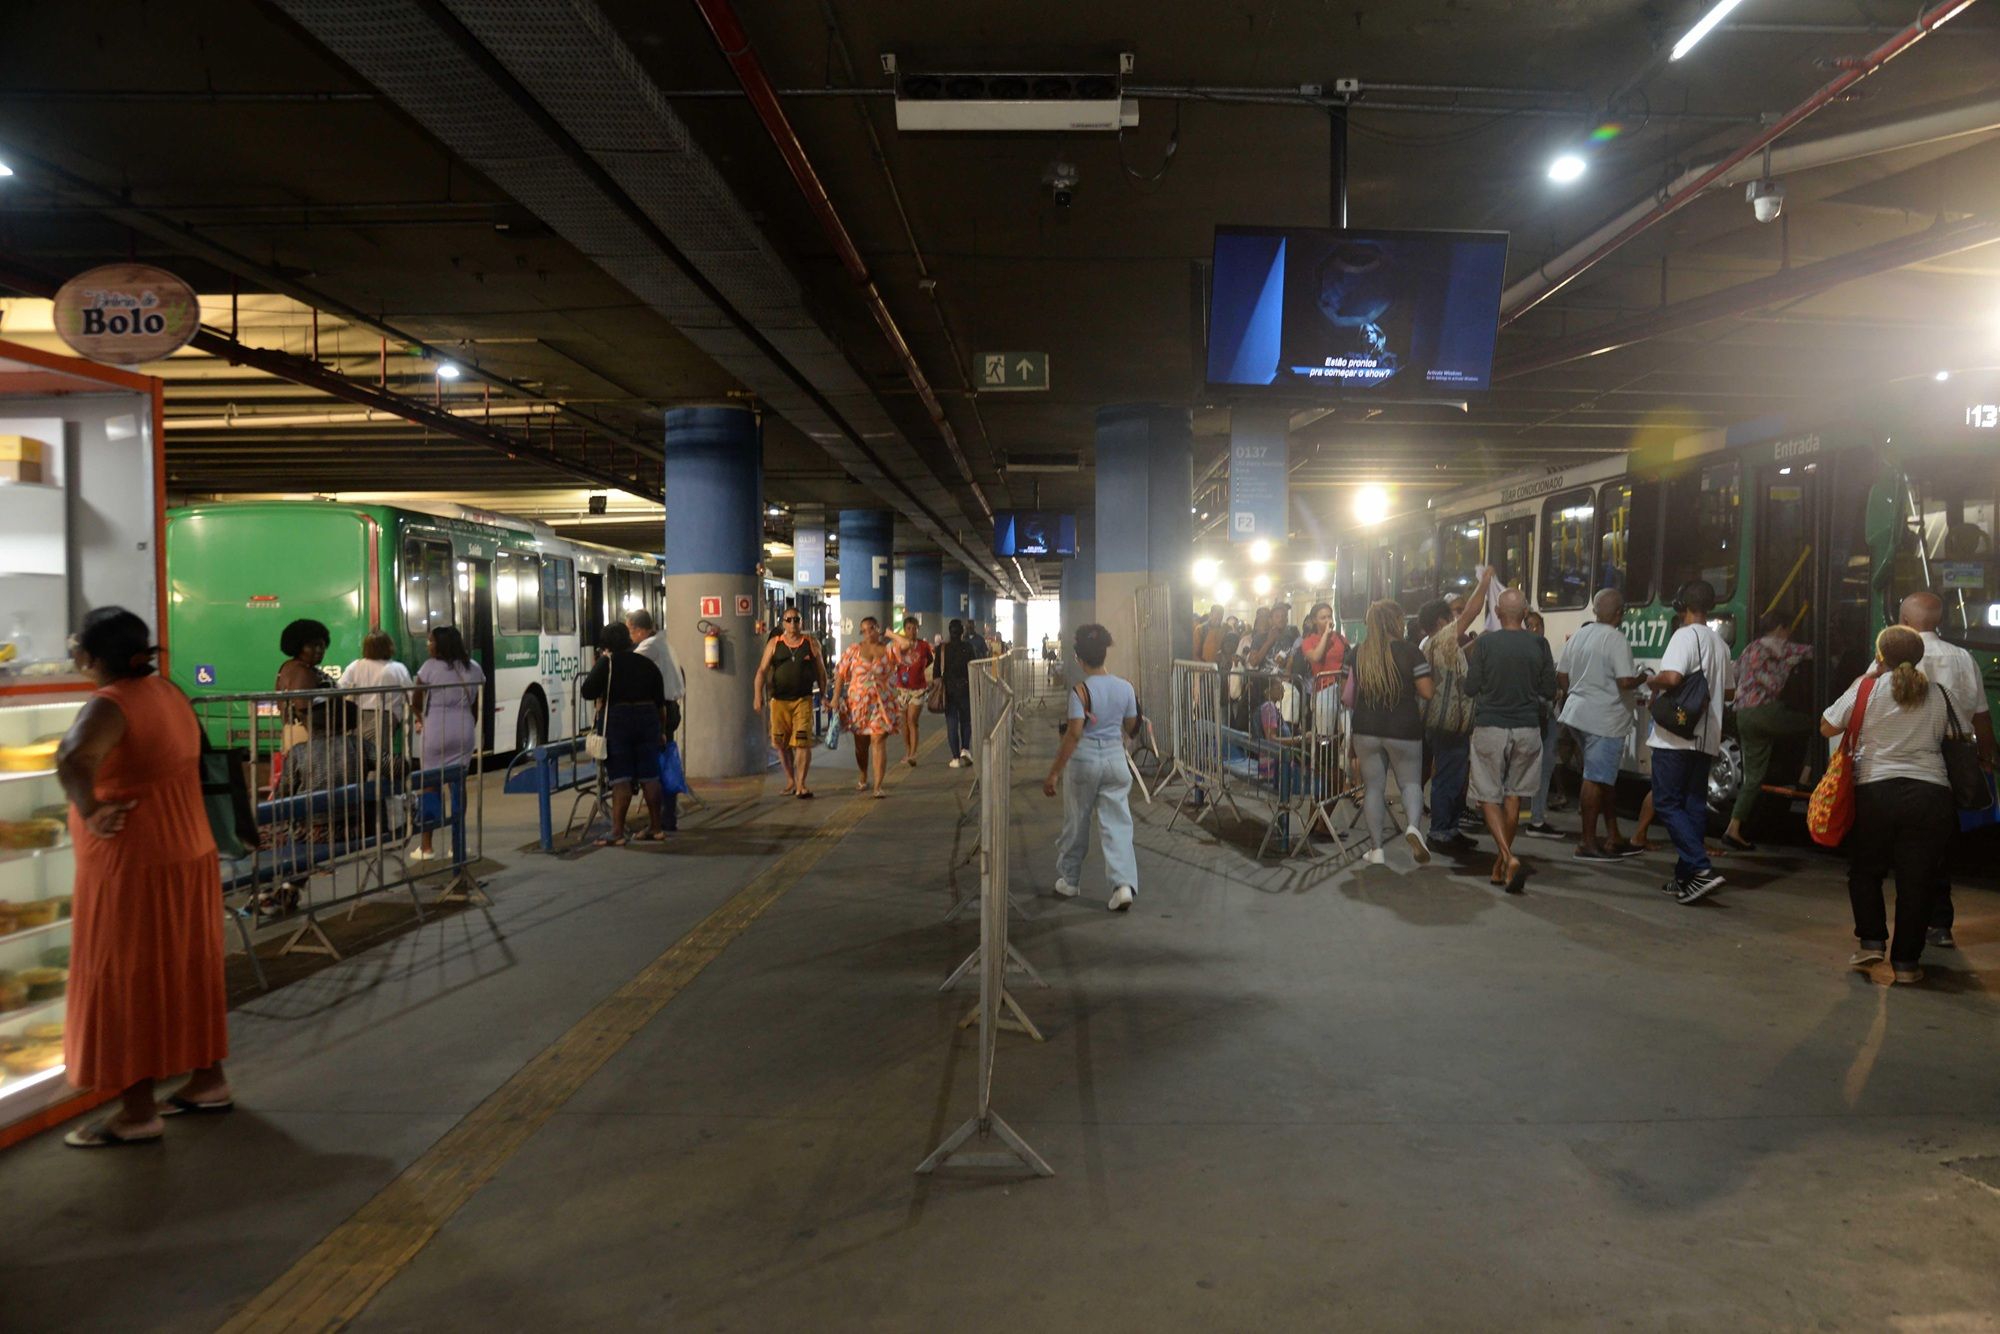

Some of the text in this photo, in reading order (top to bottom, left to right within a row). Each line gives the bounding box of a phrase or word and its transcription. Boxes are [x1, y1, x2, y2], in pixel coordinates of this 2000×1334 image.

[83, 308, 164, 334] Bolo
[1325, 357, 1377, 369] Estão prontos
[1365, 368, 1391, 378] show?
[1236, 446, 1267, 458] 0137
[1774, 433, 1820, 461] Entrada
[1237, 516, 1253, 528] F2
[872, 556, 888, 589] F
[960, 593, 969, 612] F
